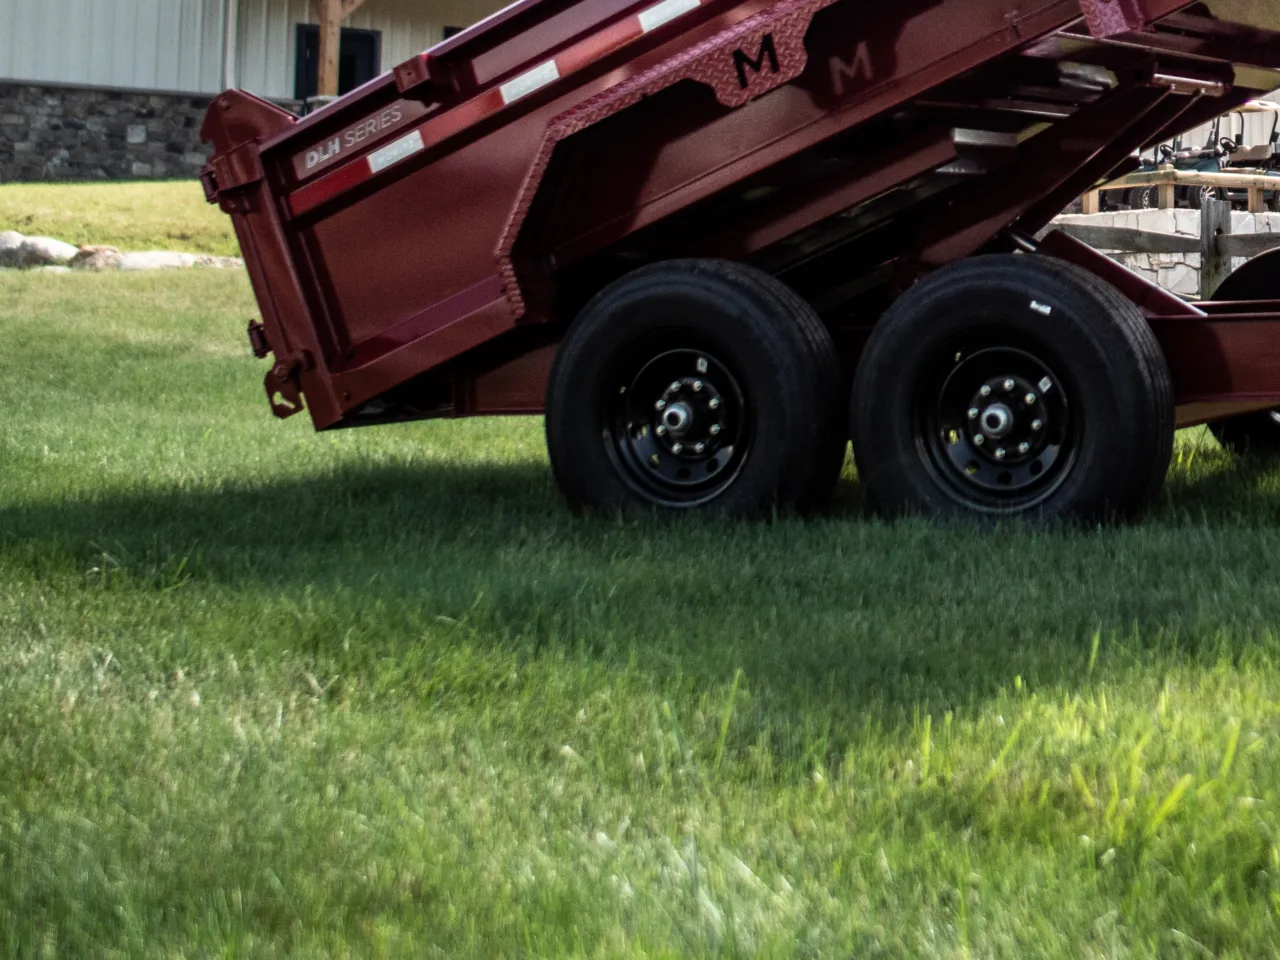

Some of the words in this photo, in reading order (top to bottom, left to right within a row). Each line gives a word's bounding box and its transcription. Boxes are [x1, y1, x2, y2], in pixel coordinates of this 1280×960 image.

[732, 32, 780, 89] M
[305, 137, 341, 169] DLH
[344, 105, 402, 148] SERIES
